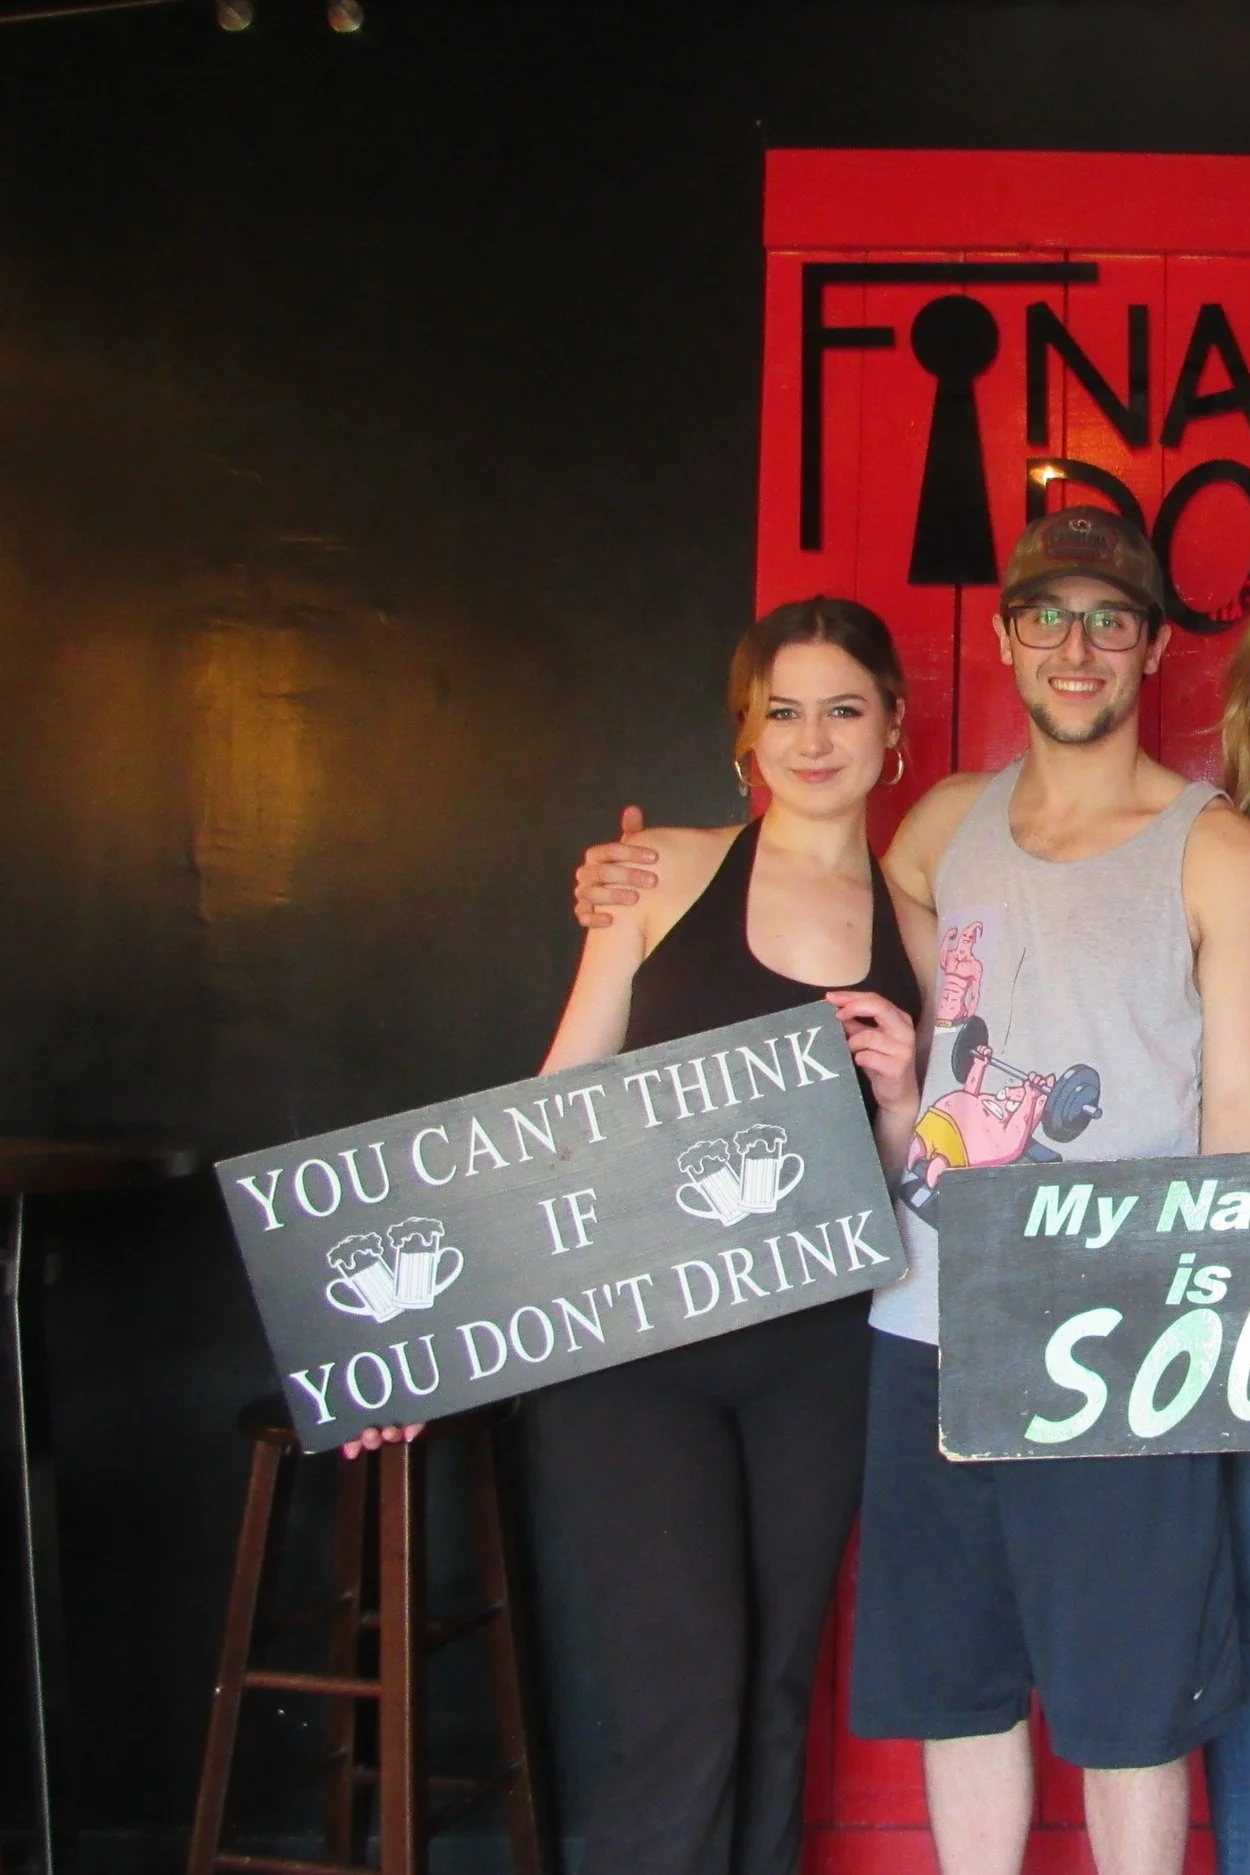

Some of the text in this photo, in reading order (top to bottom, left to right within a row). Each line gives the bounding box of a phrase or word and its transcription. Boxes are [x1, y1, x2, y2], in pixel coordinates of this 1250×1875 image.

[236, 1026, 840, 1232] YOU CAN'T THINK
[538, 1187, 602, 1255] IF
[1023, 1184, 1140, 1249] My
[1165, 1253, 1232, 1305] is
[290, 1210, 892, 1427] YOU DON'T DRINK
